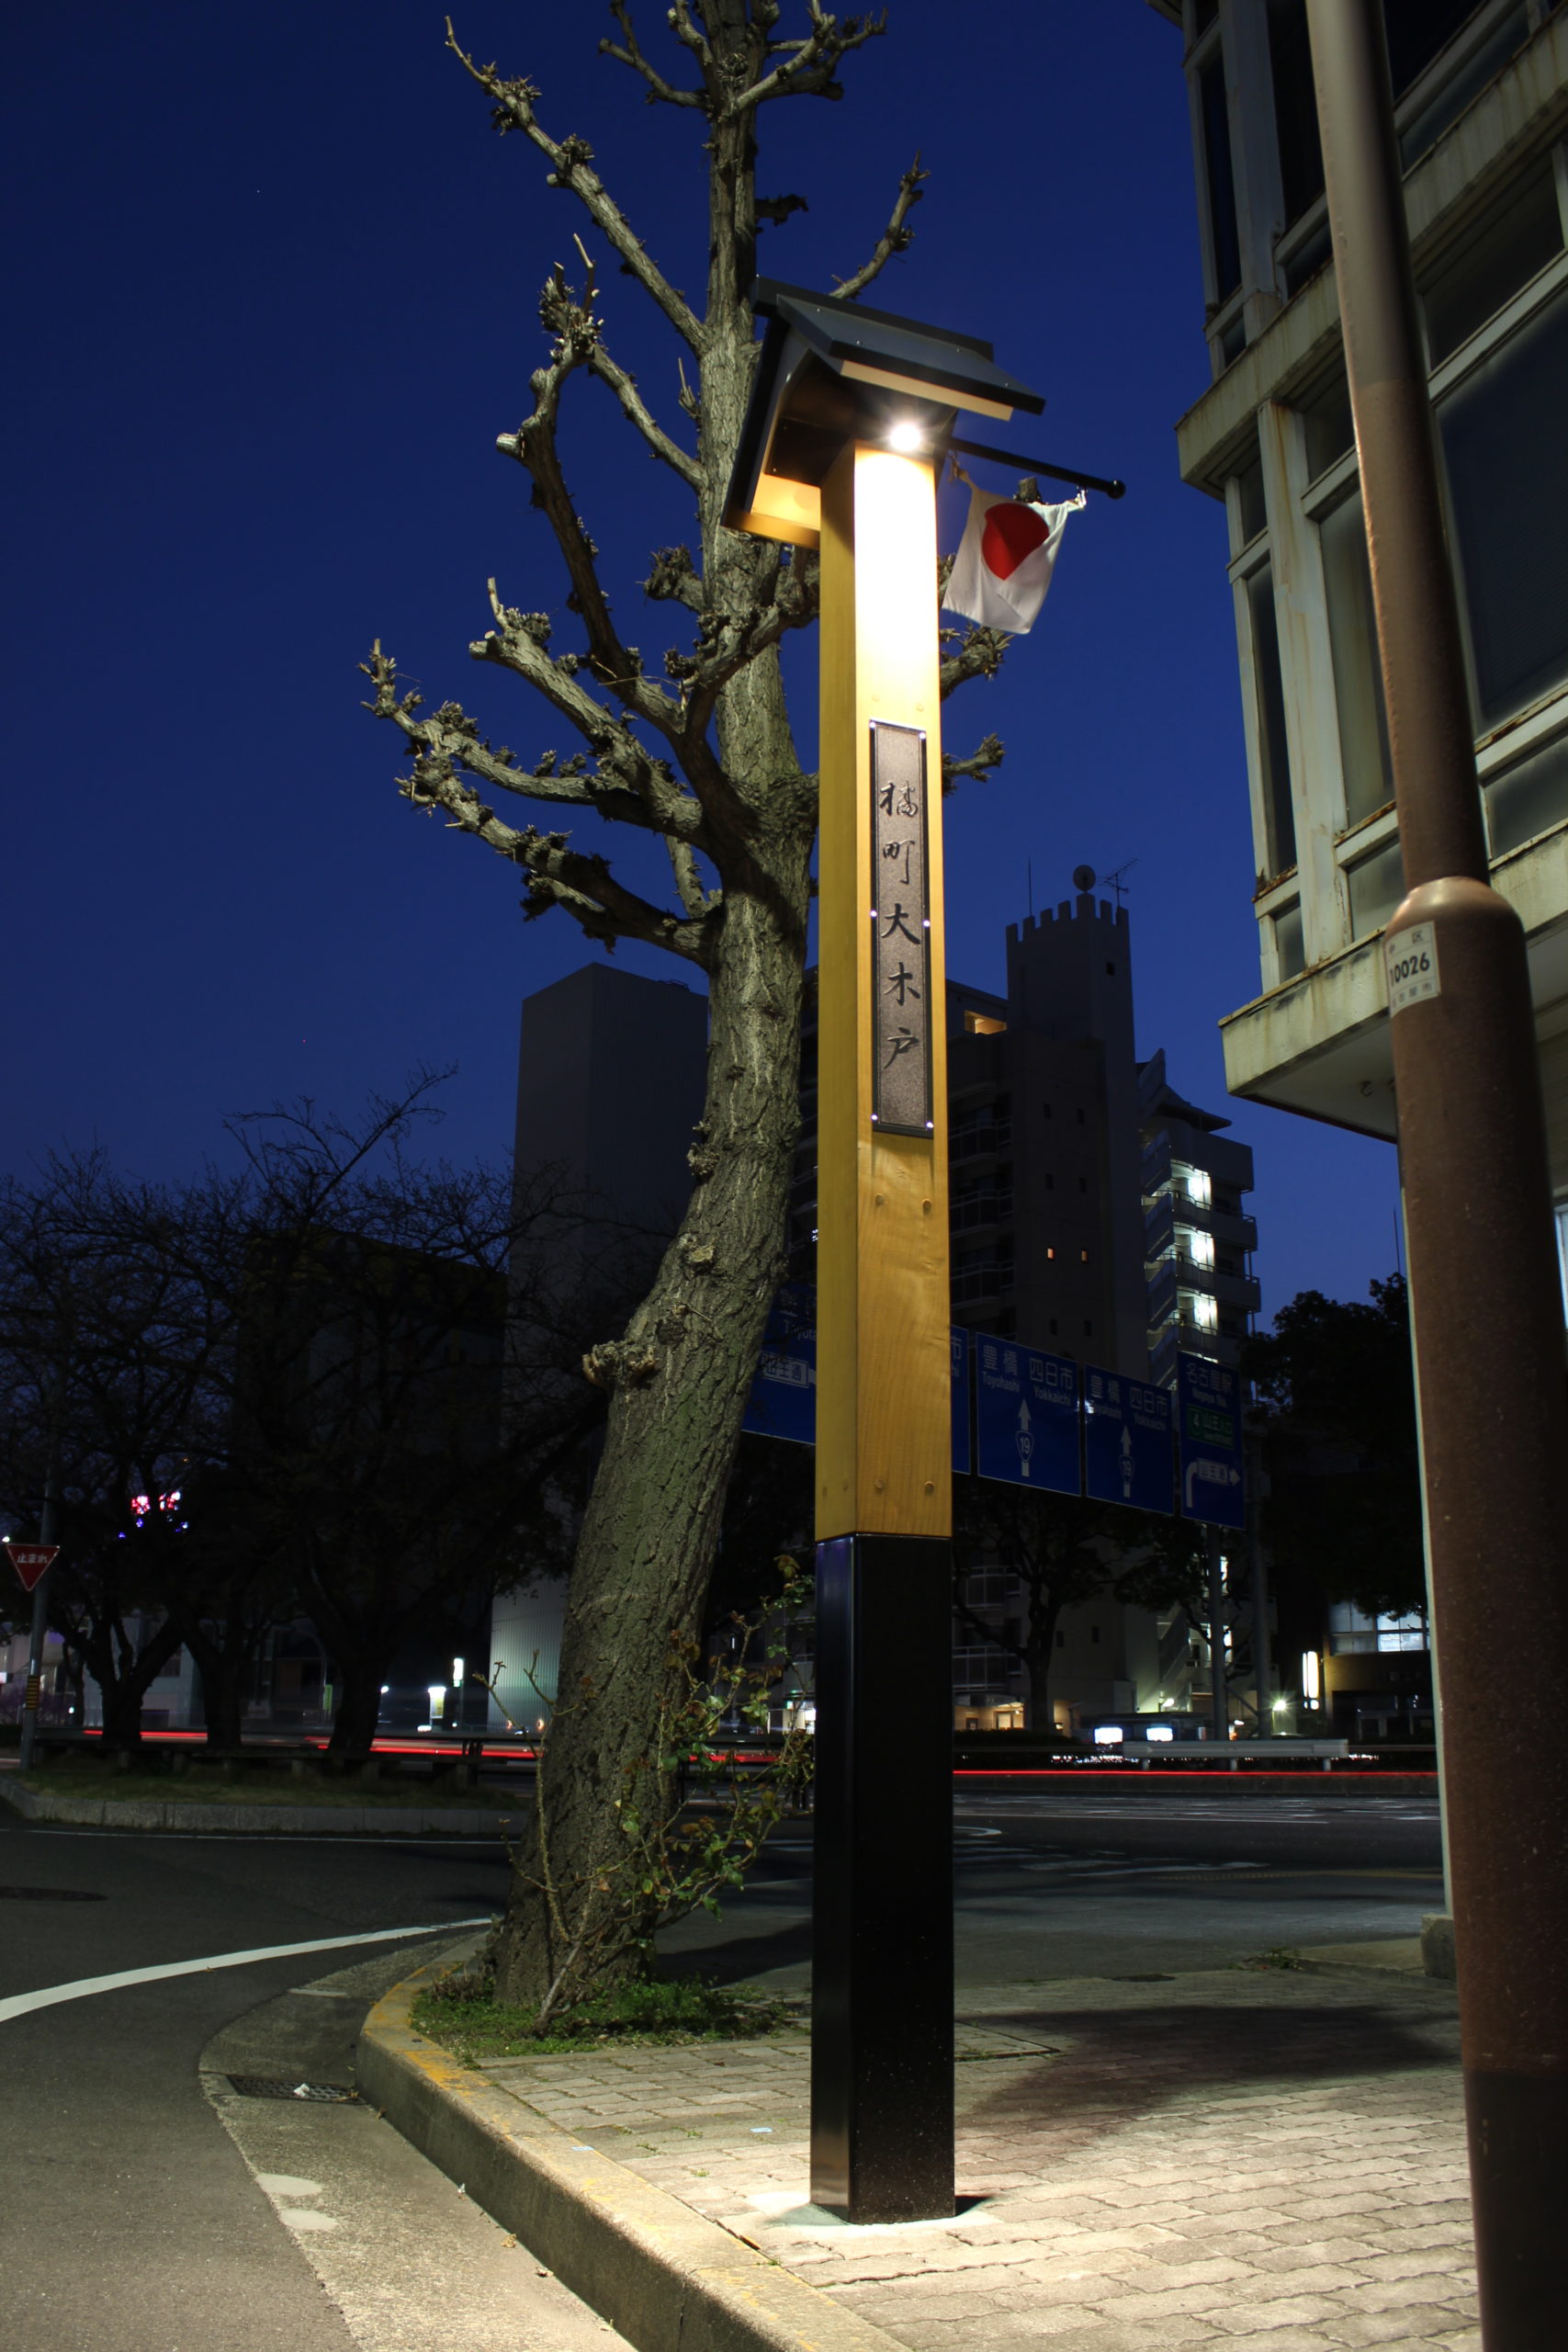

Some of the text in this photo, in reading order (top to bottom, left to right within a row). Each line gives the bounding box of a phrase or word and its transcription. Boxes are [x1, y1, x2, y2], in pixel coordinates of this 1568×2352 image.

[1390, 952, 1430, 987] 10026
[983, 1344, 1018, 1376] 豊橋
[1029, 1358, 1073, 1390] 四日市
[982, 1371, 1020, 1393] Toyohashi
[1032, 1384, 1071, 1406] Yokkaichi
[1129, 1385, 1168, 1417] 四日市
[1020, 1437, 1030, 1453] 19
[17, 1553, 48, 1565] 止まれ
